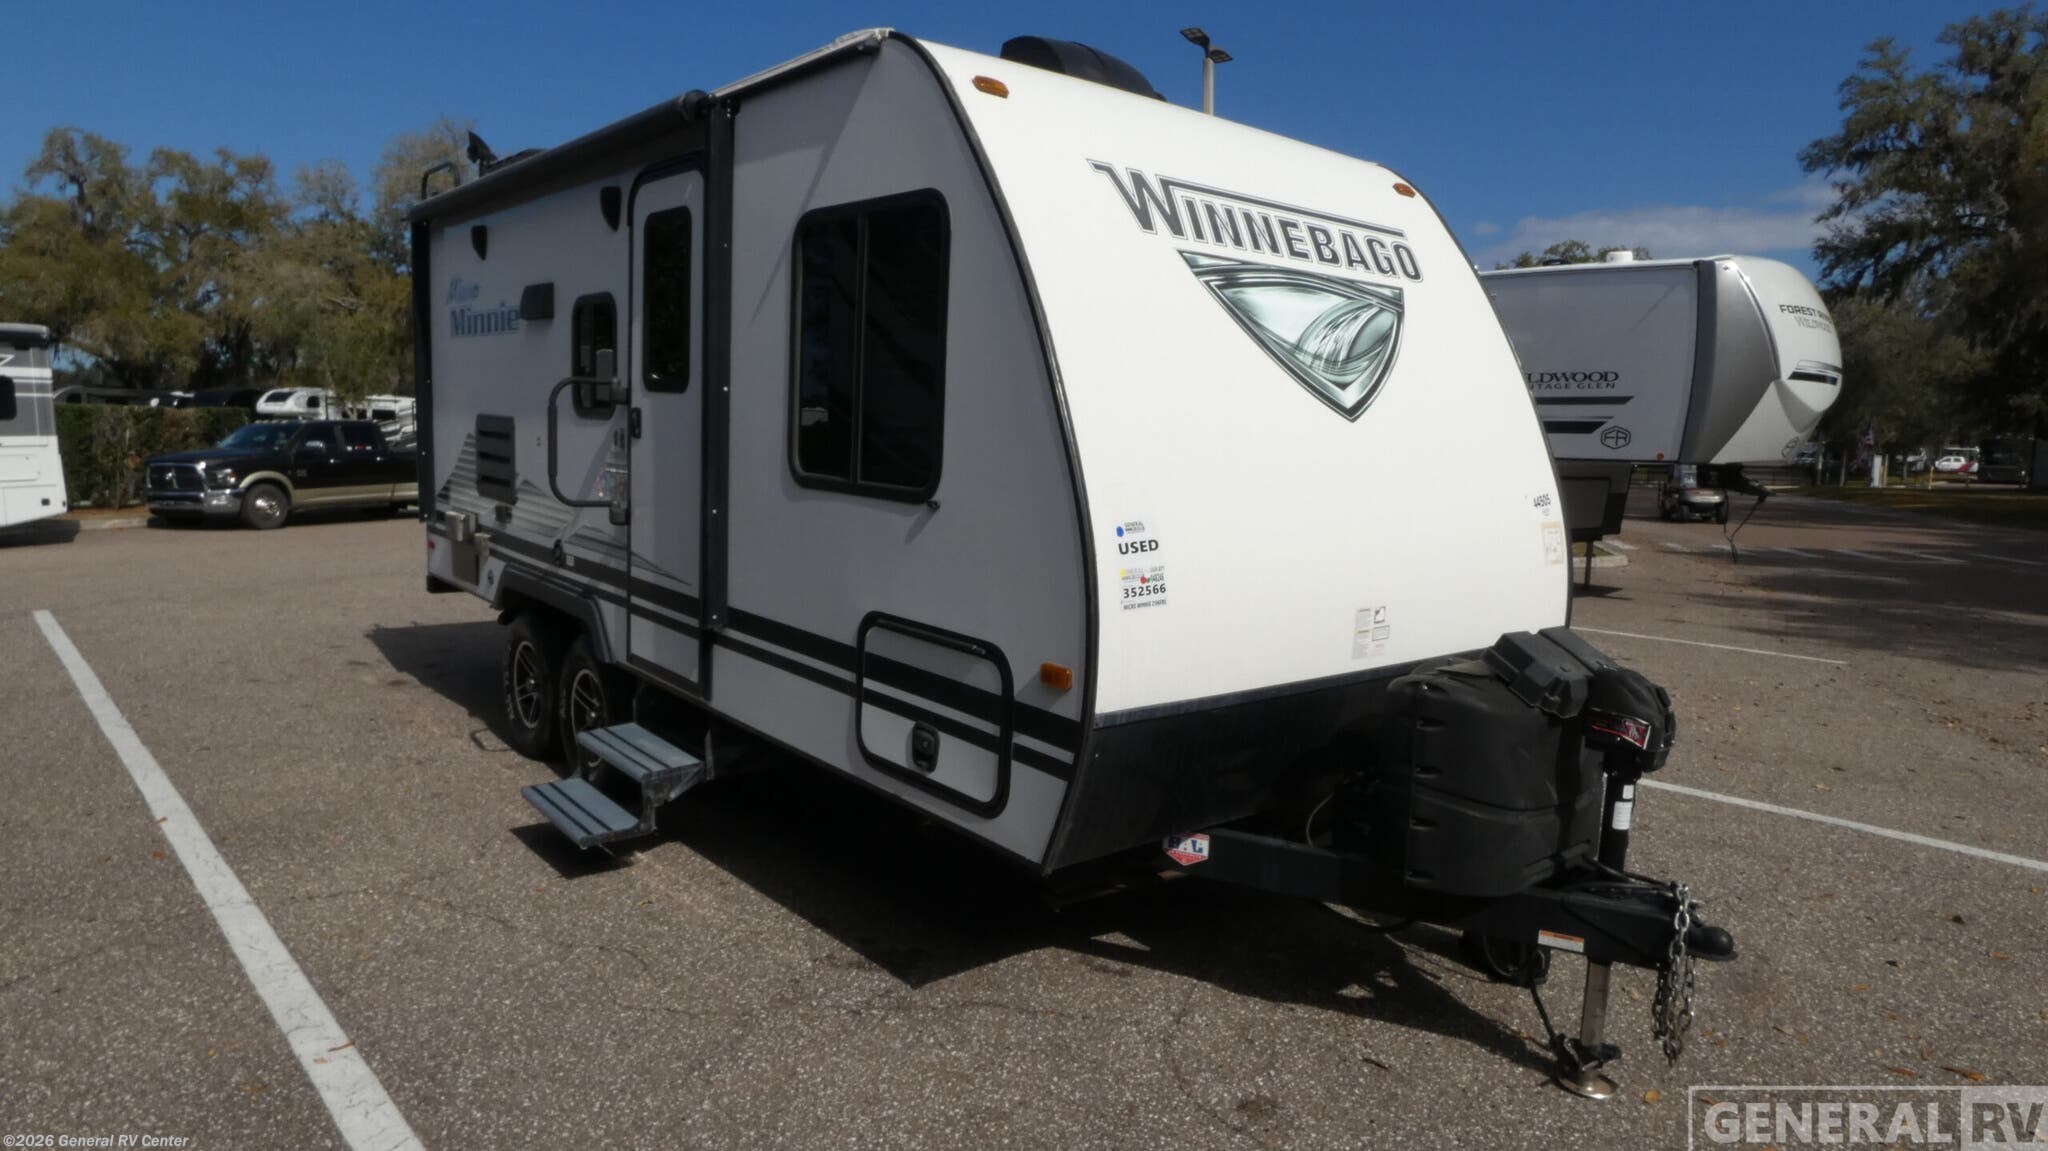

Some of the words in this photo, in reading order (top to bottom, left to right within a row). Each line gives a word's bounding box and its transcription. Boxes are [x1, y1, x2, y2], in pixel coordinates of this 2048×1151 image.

[1086, 158, 1423, 282] WINNEBAGO
[1778, 304, 1817, 316] FOREST
[451, 300, 521, 337] Minnie
[1526, 371, 1620, 384] LDWOOD
[1577, 382, 1616, 390] GLEN
[1118, 539, 1159, 555] USED
[1123, 583, 1167, 599] 352566
